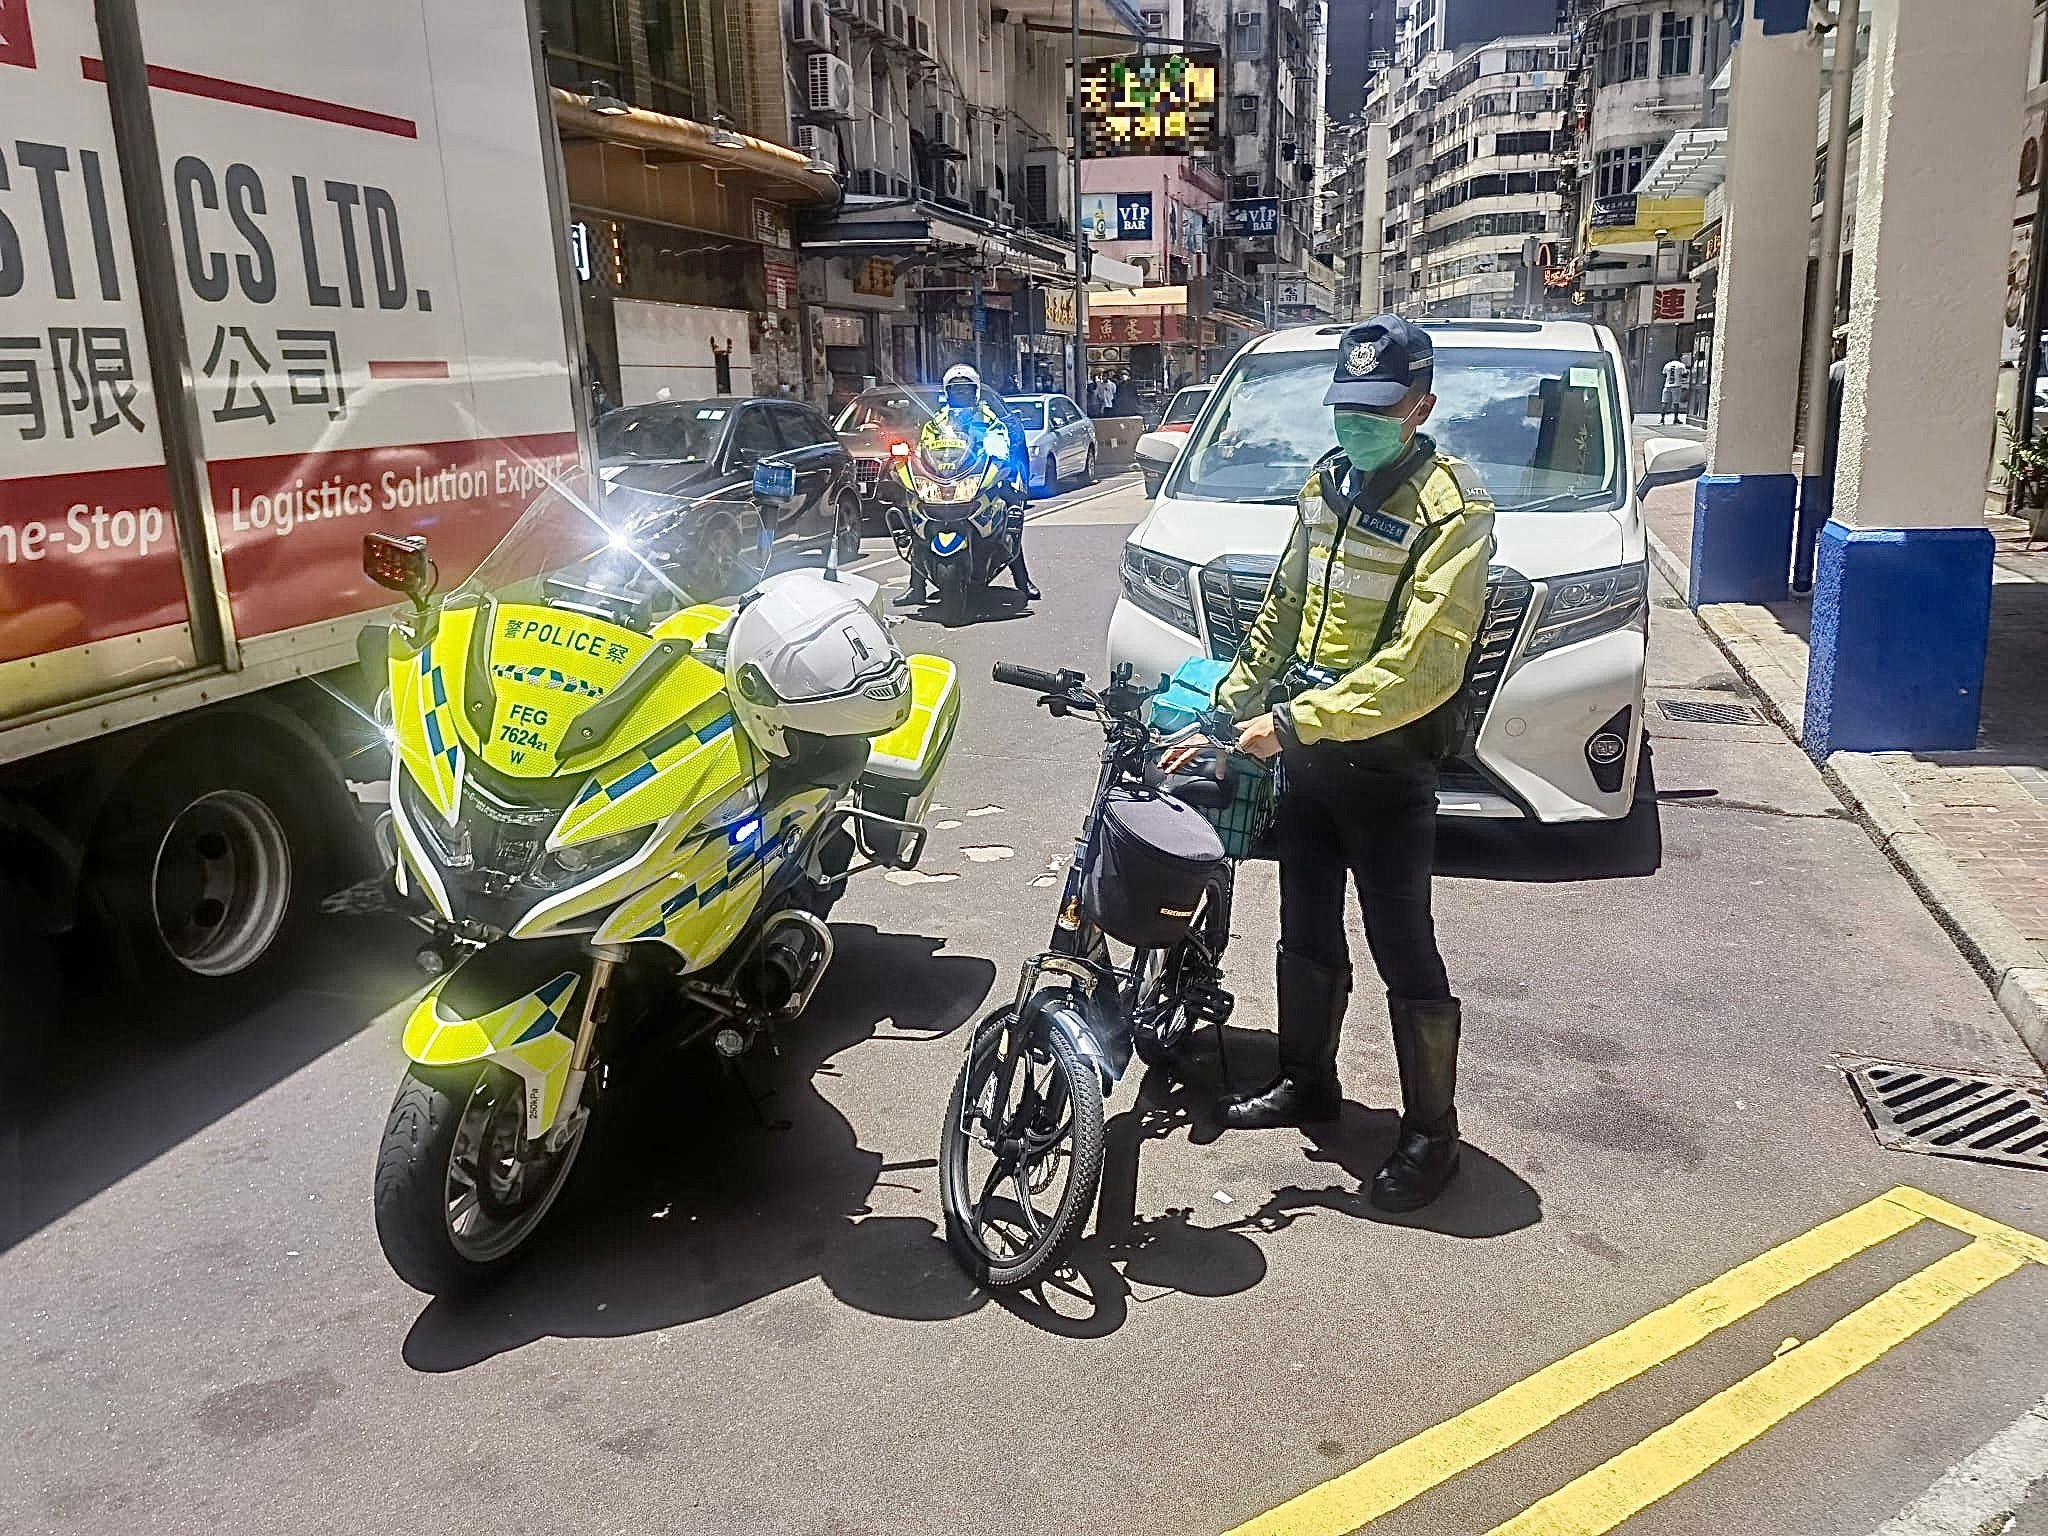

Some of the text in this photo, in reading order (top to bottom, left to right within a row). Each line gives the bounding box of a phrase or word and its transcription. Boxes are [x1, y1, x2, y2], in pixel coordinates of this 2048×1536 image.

[1119, 205, 1150, 221] VIP
[1248, 208, 1276, 222] VIP
[1124, 220, 1146, 230] BAR
[1253, 222, 1273, 231] BAR
[292, 175, 432, 312] LTD.
[231, 475, 373, 536] Logistics
[381, 465, 489, 510] Solution
[495, 455, 563, 501] Expert
[522, 621, 606, 657] POLICE
[509, 703, 549, 726] FEG
[511, 749, 526, 765] W
